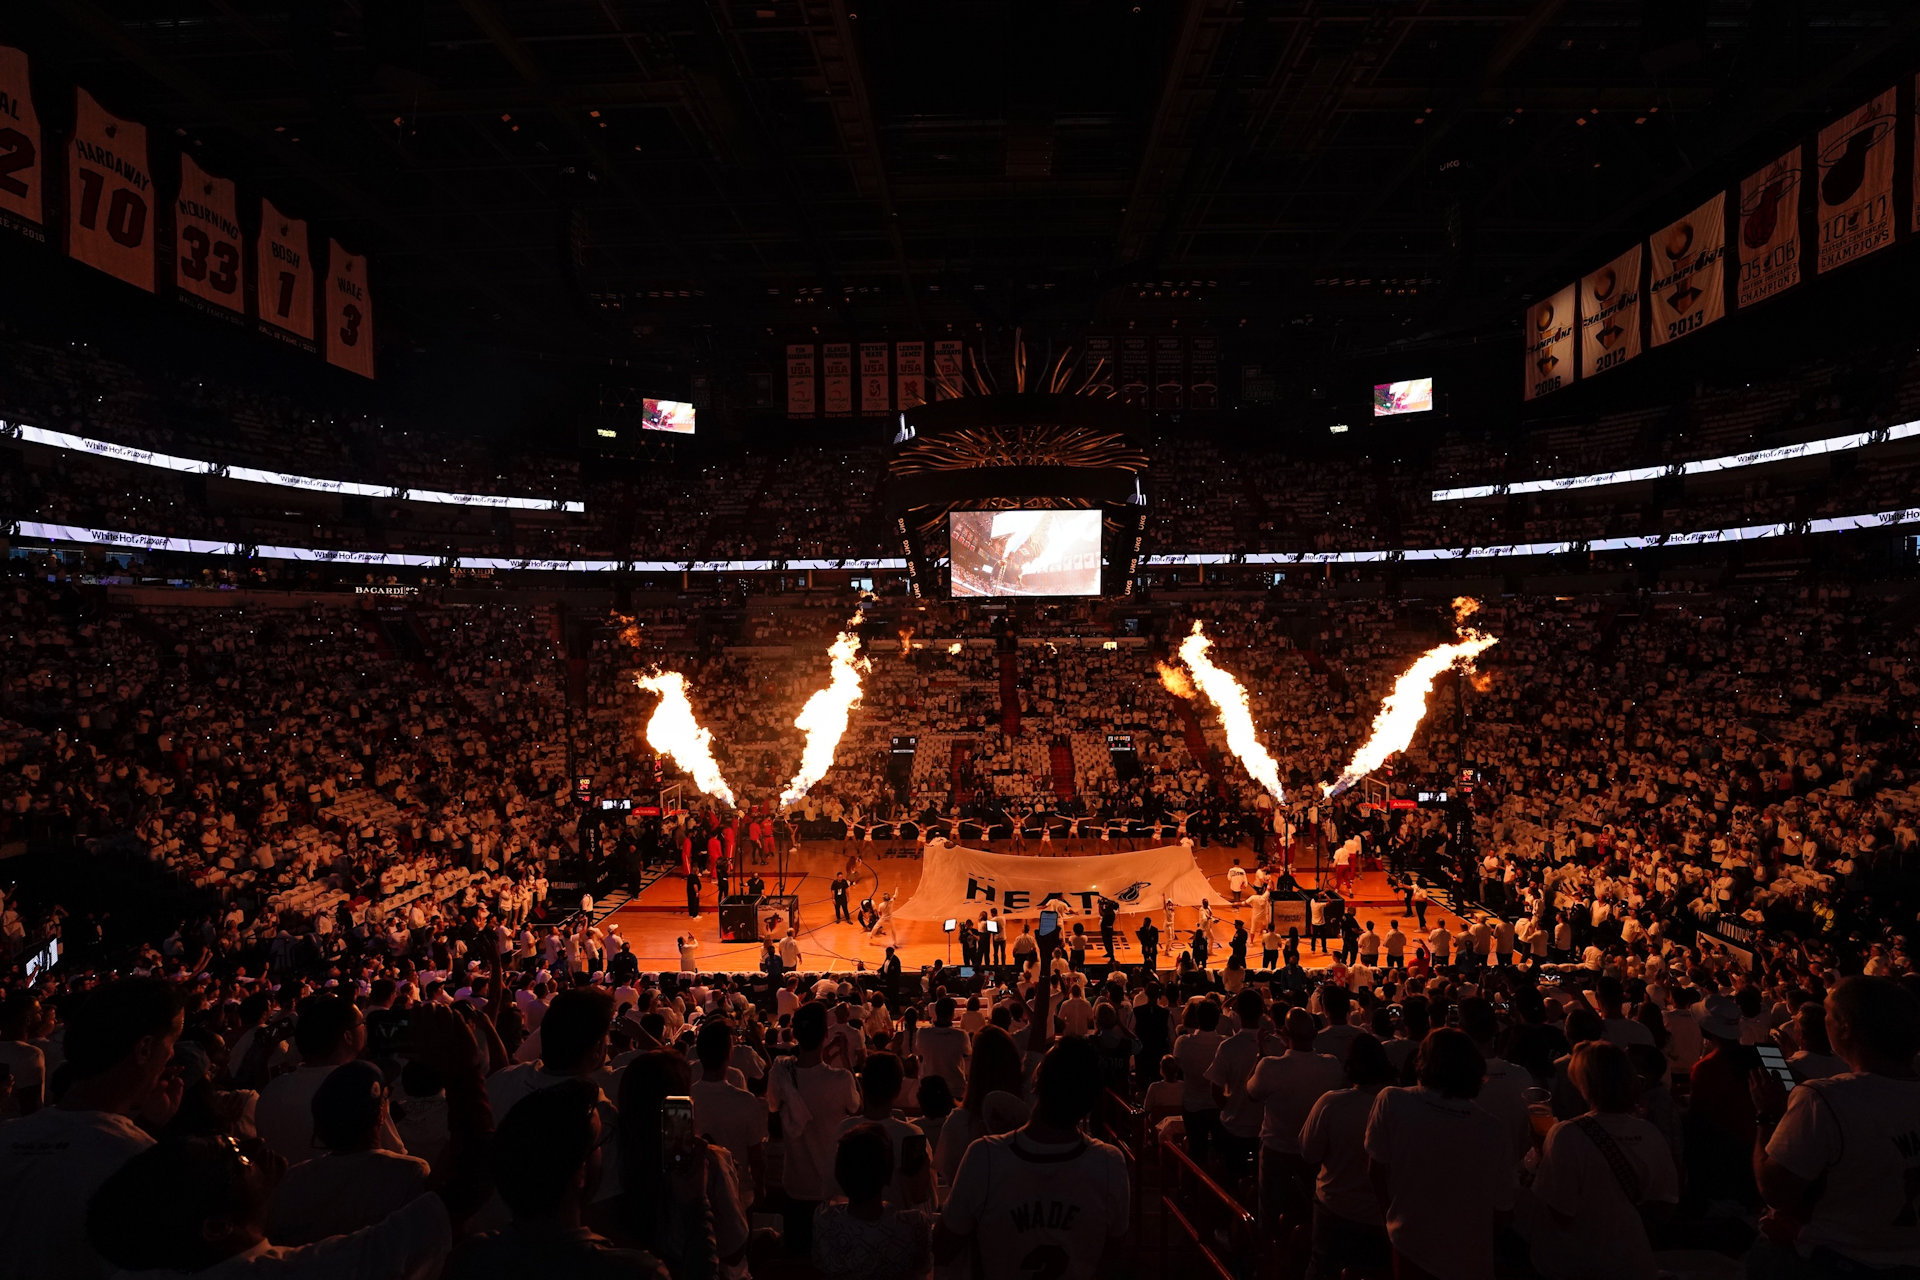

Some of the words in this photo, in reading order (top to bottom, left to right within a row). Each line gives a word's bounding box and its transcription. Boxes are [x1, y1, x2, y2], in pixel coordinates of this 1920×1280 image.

[75, 138, 150, 192] HARDAWAY
[79, 167, 148, 249] 10
[178, 199, 240, 240] MOURNING
[1823, 214, 1846, 244] 10
[1865, 195, 1887, 225] 11
[181, 224, 240, 295] 33
[271, 241, 301, 269] BOSH
[1774, 239, 1796, 267] 06
[1821, 229, 1889, 268] CHAMPIONS
[277, 271, 296, 318] 1
[337, 277, 363, 303] WADE
[1740, 271, 1798, 305] CHAMPIONS
[340, 303, 362, 347] 3
[1668, 310, 1704, 339] 2013
[790, 366, 811, 375] USA
[827, 365, 848, 374] USA
[864, 364, 885, 373] USA
[900, 363, 922, 373] USA
[1595, 347, 1626, 372] 2012
[1535, 375, 1561, 396] 2006
[84, 440, 108, 452] White
[898, 517, 906, 534] UKG
[1138, 514, 1147, 530] UKG
[91, 529, 119, 542] White
[902, 539, 911, 555] UKG
[1133, 536, 1142, 552] UKG
[908, 561, 916, 577] UKG
[1129, 558, 1137, 573] UKG
[912, 582, 921, 599] UKG
[1124, 580, 1133, 596] UKG
[1010, 1200, 1081, 1234] WADE
